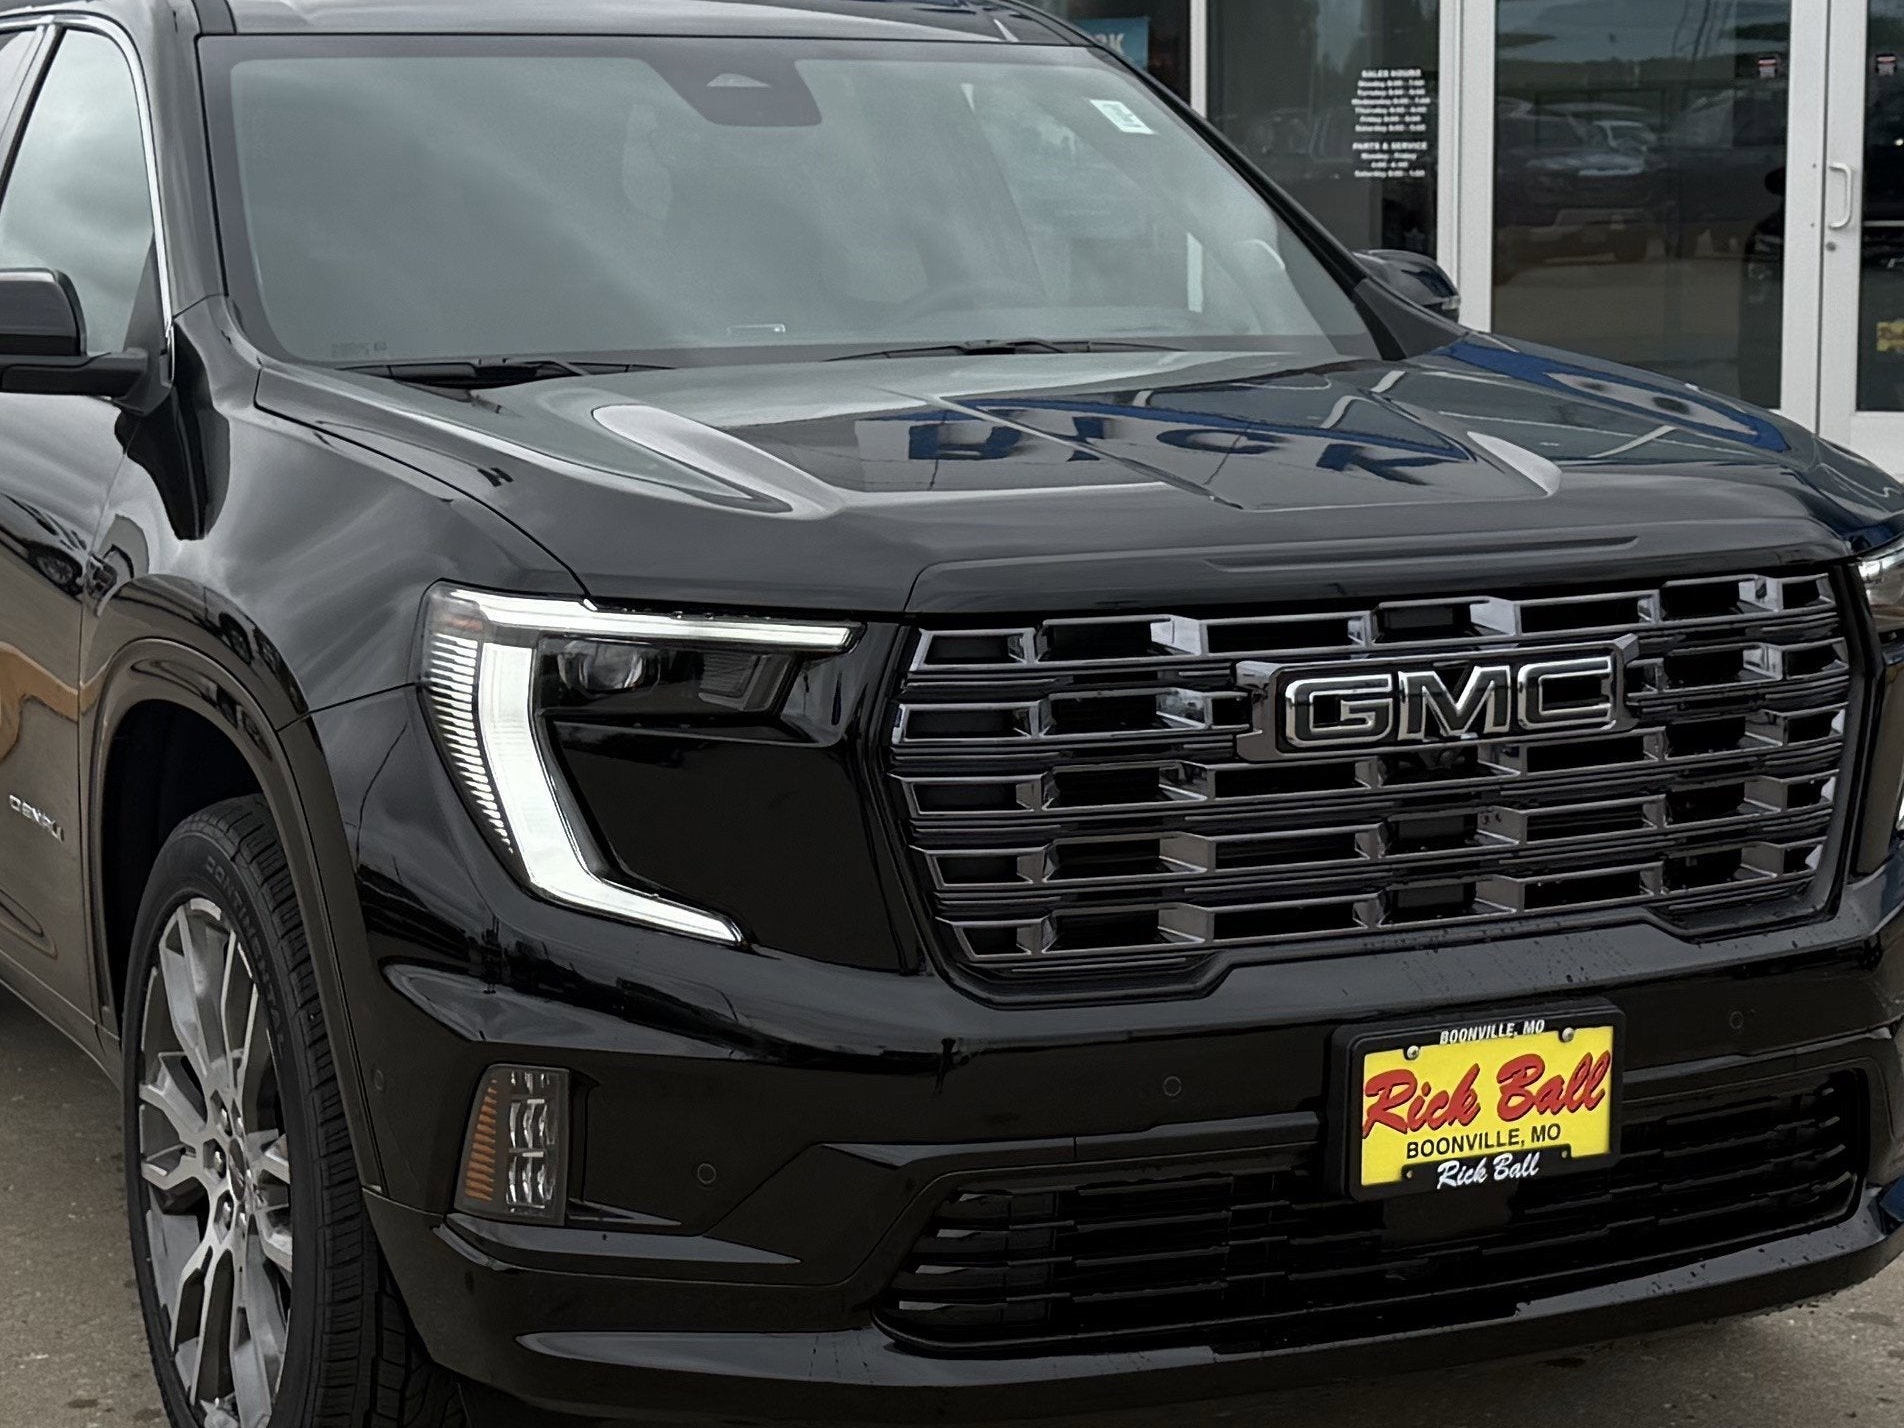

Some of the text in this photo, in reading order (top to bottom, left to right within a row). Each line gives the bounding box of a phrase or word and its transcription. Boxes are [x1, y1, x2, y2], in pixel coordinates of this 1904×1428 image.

[1285, 656, 1615, 748] GMC
[1440, 1019, 1545, 1045] BOONVILLE, MO
[1363, 1050, 1611, 1139] Rick Ball
[1406, 1122, 1561, 1160] BOONVILLE, MO
[1436, 1152, 1539, 1190] Rick Ball
